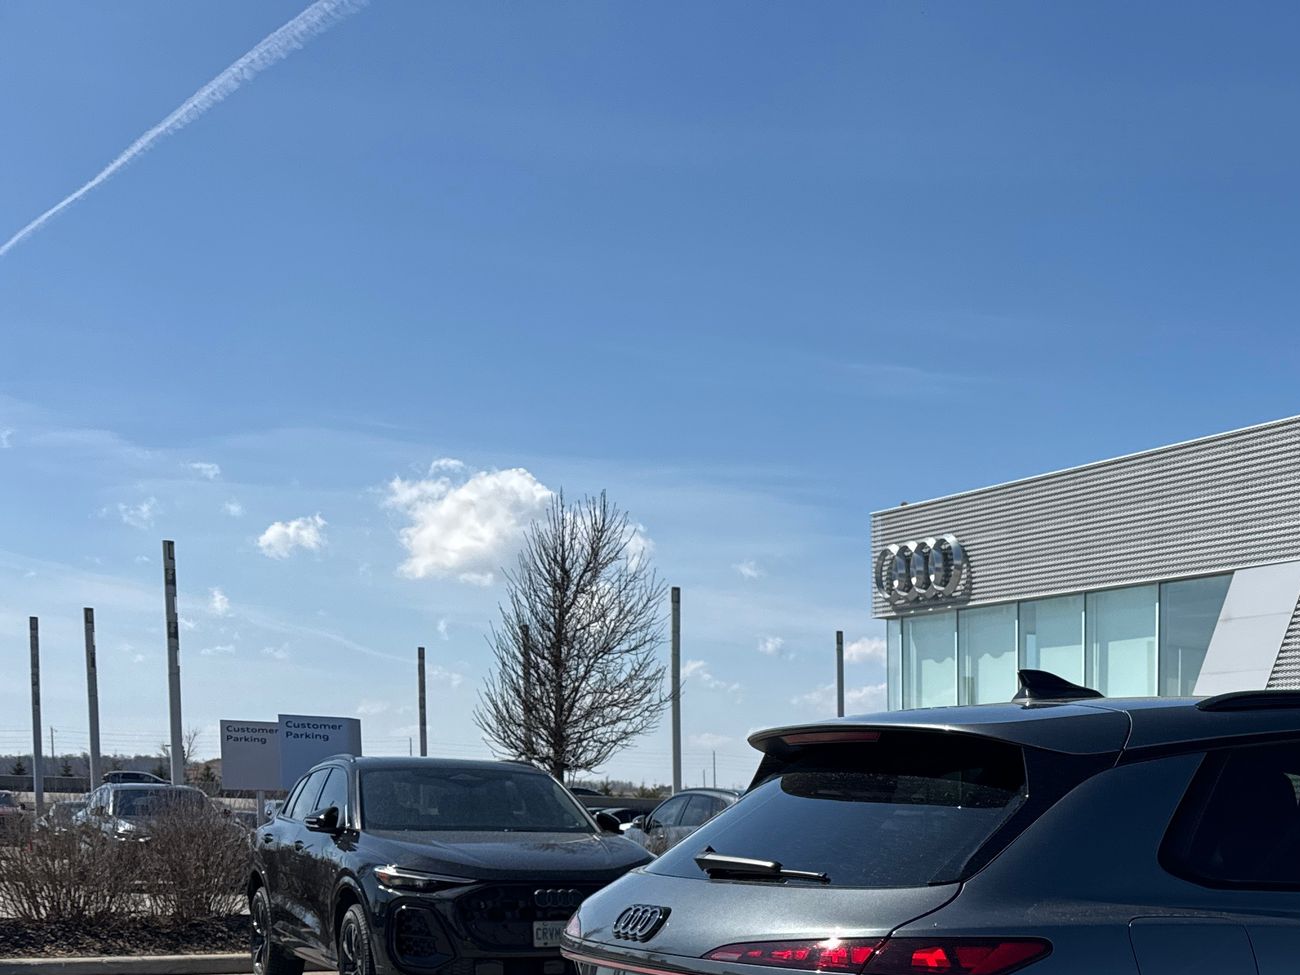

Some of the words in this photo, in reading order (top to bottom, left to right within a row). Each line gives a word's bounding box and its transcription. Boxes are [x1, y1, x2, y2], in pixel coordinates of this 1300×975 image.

[226, 725, 279, 734] Customer
[285, 720, 343, 730] Customer
[226, 735, 267, 744] Parking
[285, 731, 329, 742] Parking
